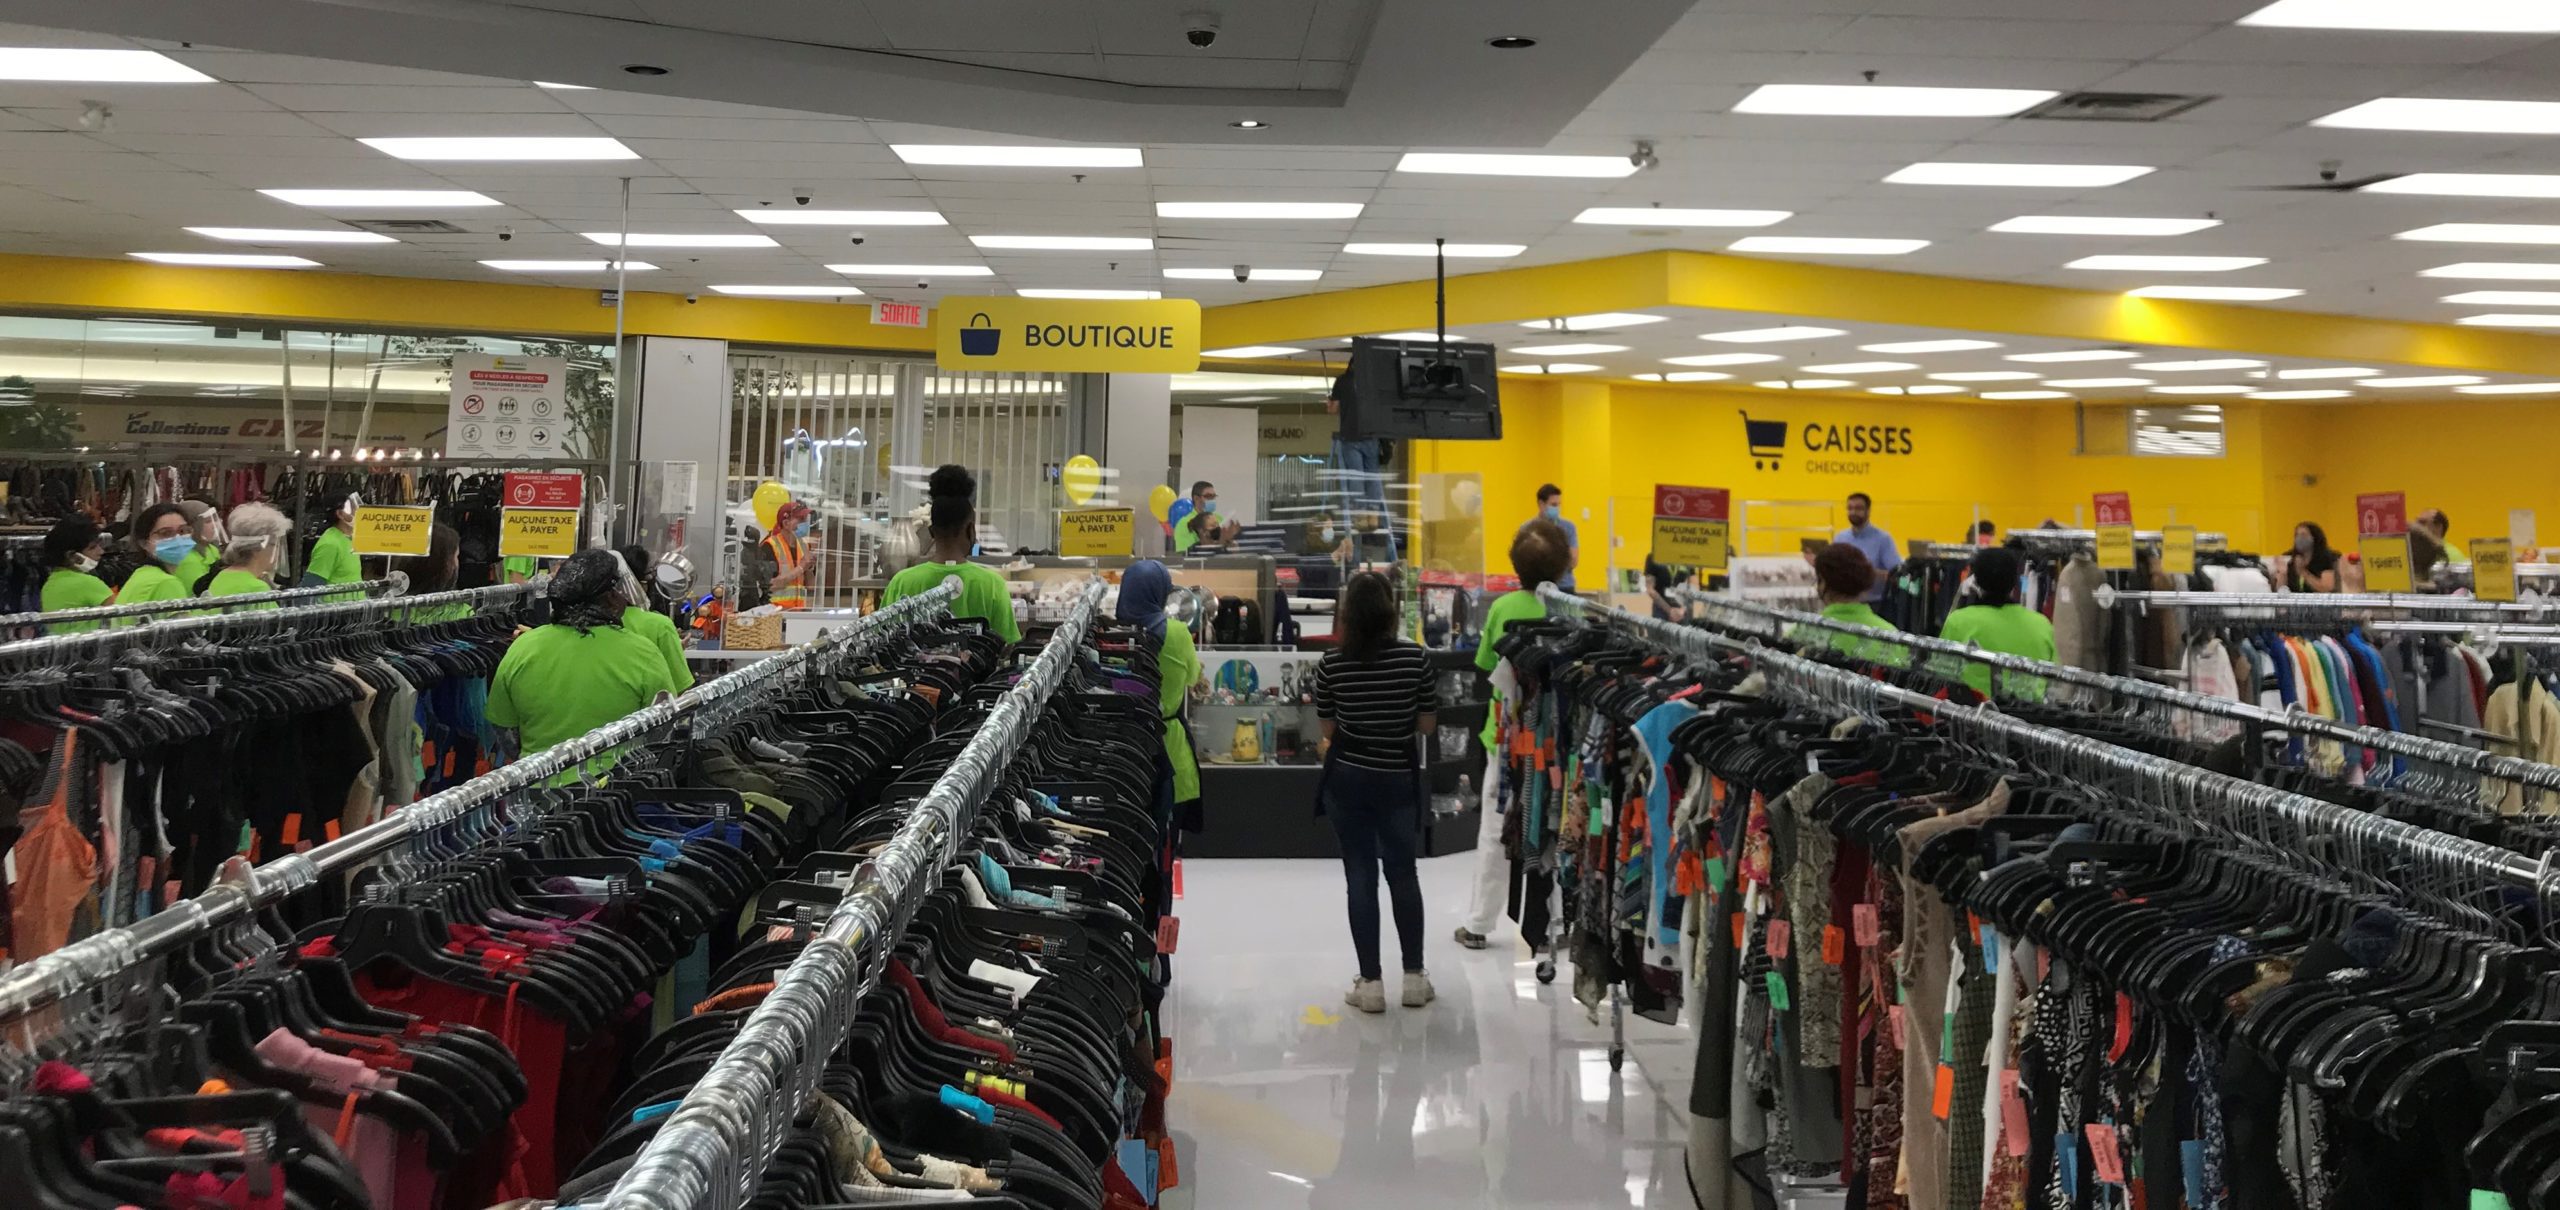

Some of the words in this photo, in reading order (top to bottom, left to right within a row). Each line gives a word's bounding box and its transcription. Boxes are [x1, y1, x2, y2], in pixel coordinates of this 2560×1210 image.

[880, 303, 921, 326] SORTIE
[1025, 324, 1174, 348] BOUTIQUE
[126, 421, 231, 436] Collections
[1263, 428, 1304, 439] ISLAND
[1803, 423, 1913, 455] CAISSES
[1806, 460, 1870, 474] CHECKOUT
[361, 513, 401, 522] AUCUNE
[403, 514, 427, 523] TAXE
[508, 516, 548, 524] AUCUNE
[550, 516, 573, 525] TAXE
[1065, 514, 1104, 524] AUCUNE
[1106, 514, 1129, 523] TAXE
[383, 523, 412, 532] PAYER
[530, 526, 559, 535] PAYER
[1088, 524, 1116, 533] PAYER
[1659, 525, 1697, 535] AUCUNE
[1699, 528, 1722, 537] TAXE
[1680, 536, 1709, 545] PAYER
